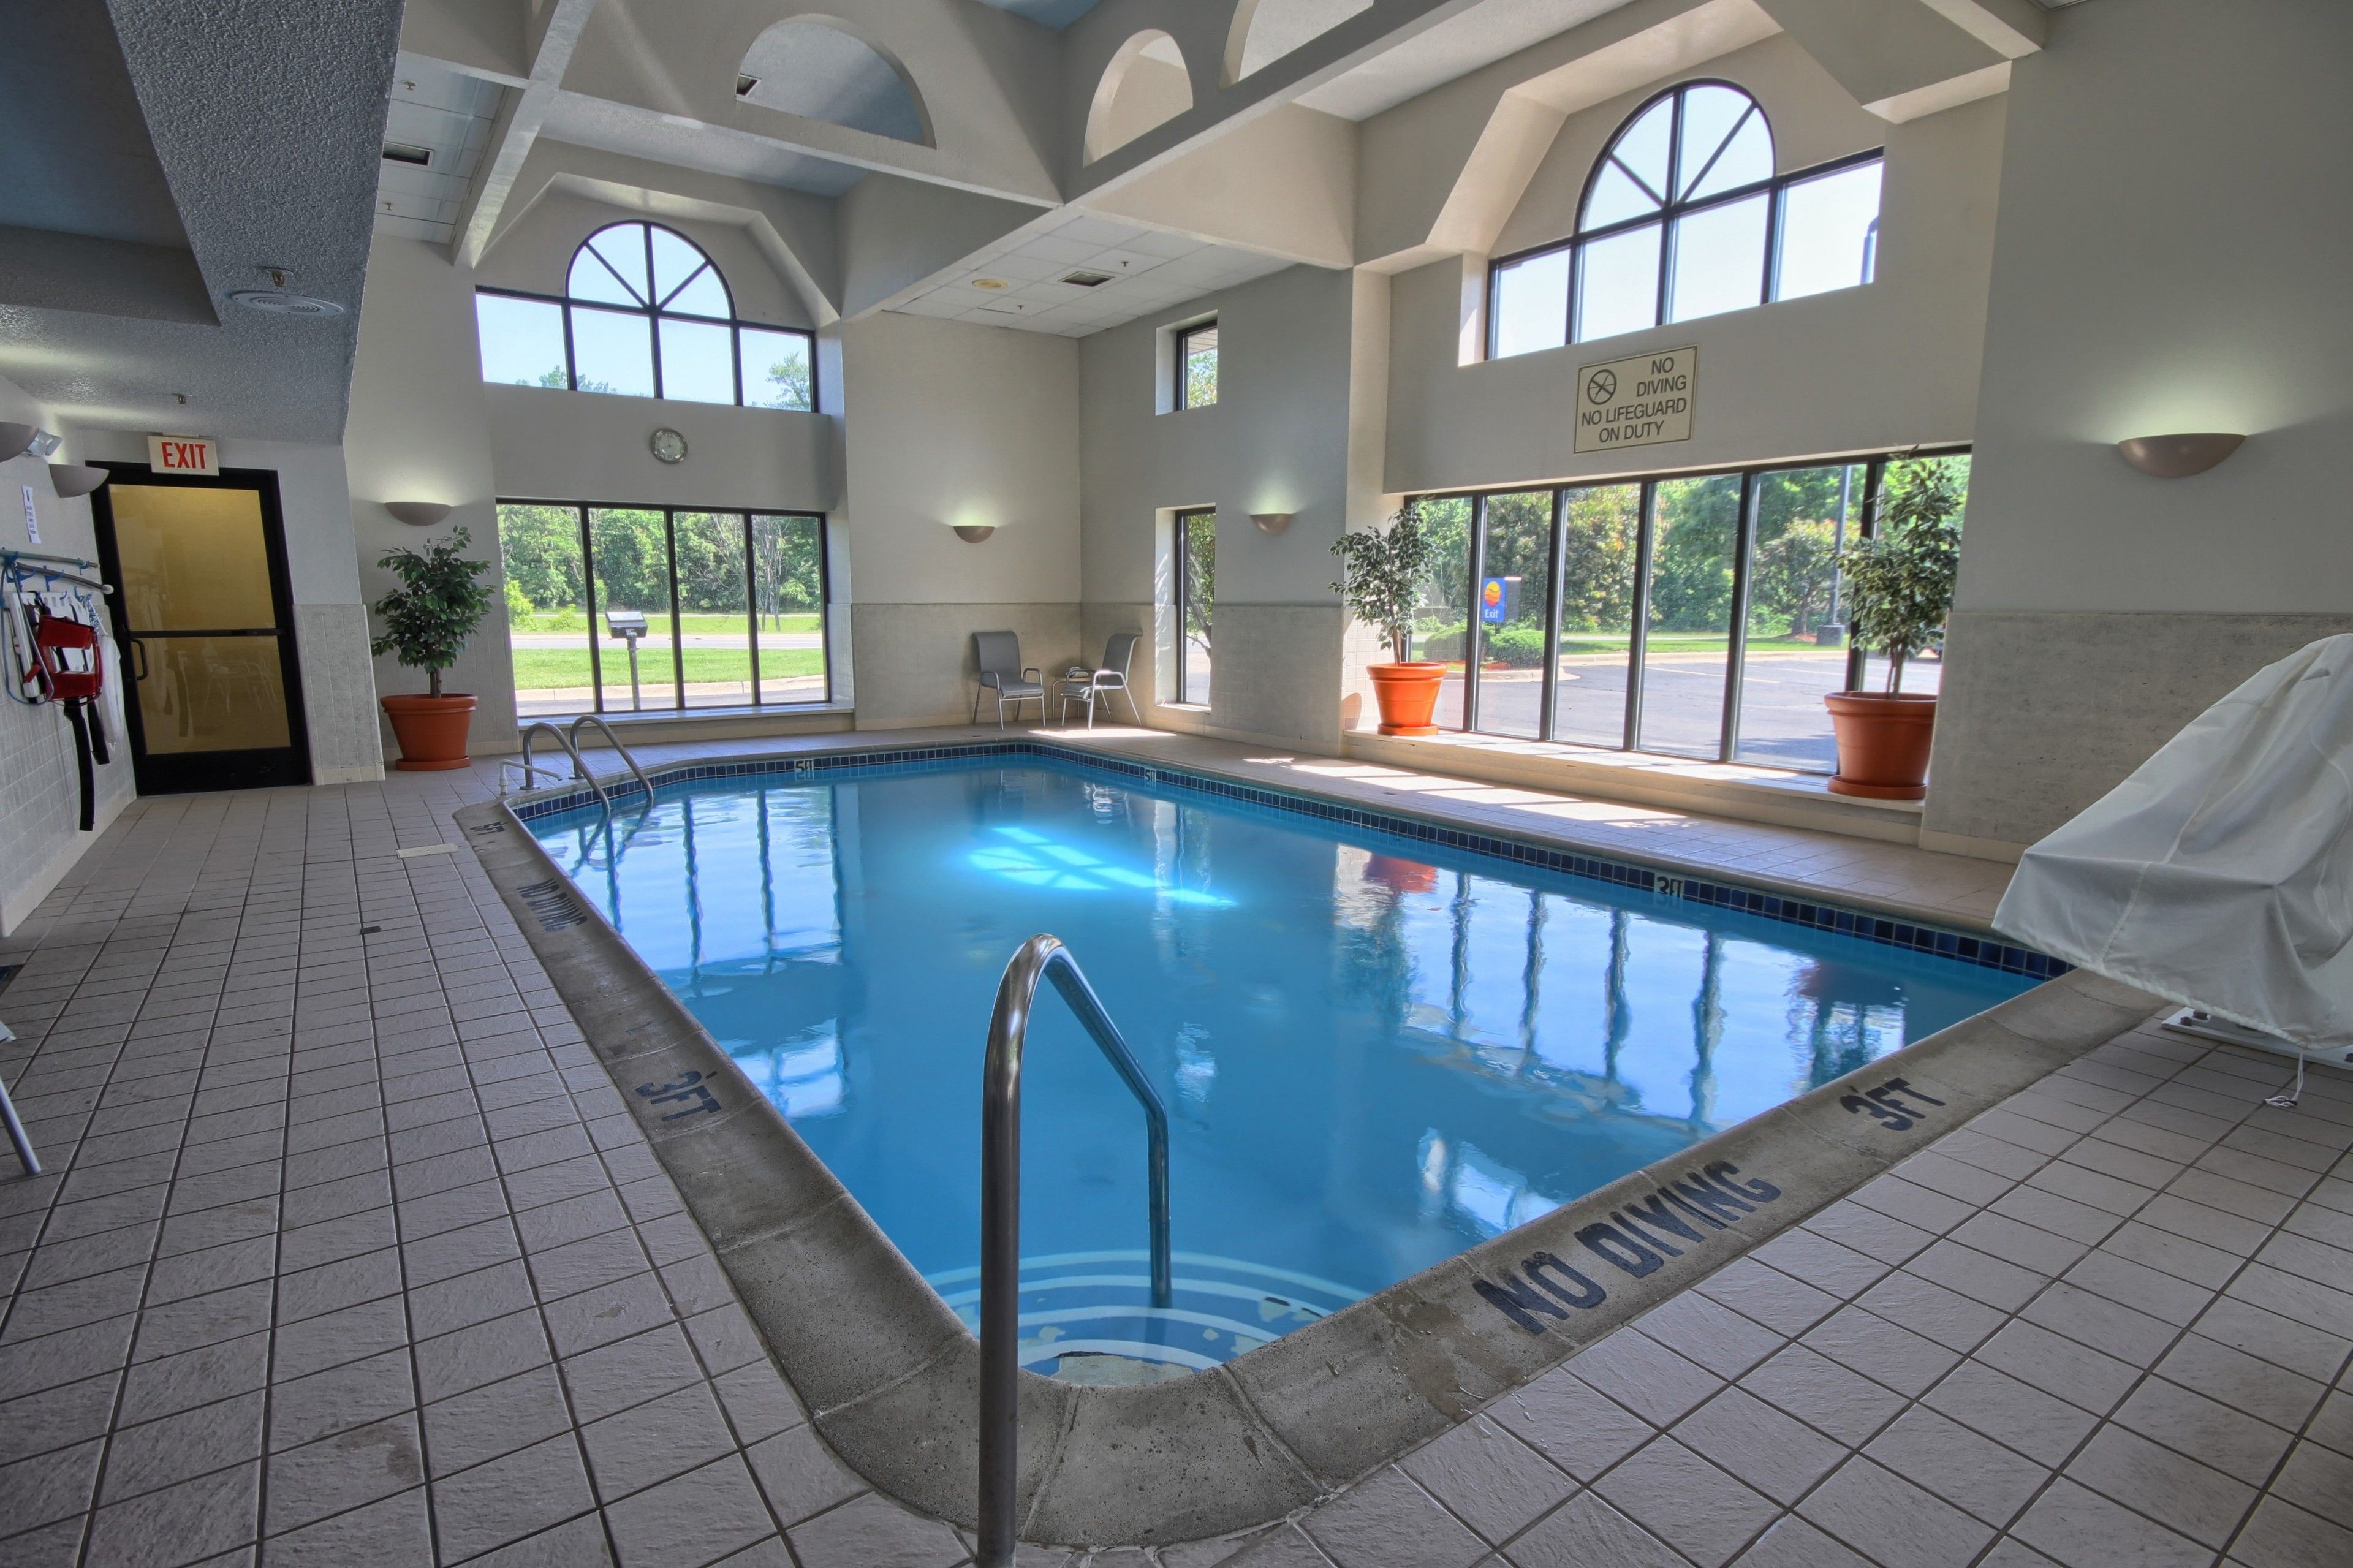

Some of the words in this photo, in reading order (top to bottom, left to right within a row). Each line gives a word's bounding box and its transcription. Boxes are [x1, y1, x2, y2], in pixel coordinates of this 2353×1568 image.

[1651, 357, 1674, 375] NO
[1637, 375, 1686, 397] DIVING
[1582, 410, 1602, 426] NO
[1606, 398, 1687, 423] LIFEGUARD
[1599, 426, 1620, 442] ON
[1624, 420, 1664, 440] DUTY
[161, 442, 206, 469] EXIT
[1485, 609, 1498, 618] Exit
[1472, 1251, 1607, 1334] NO
[1574, 1160, 1781, 1279] DIVING
